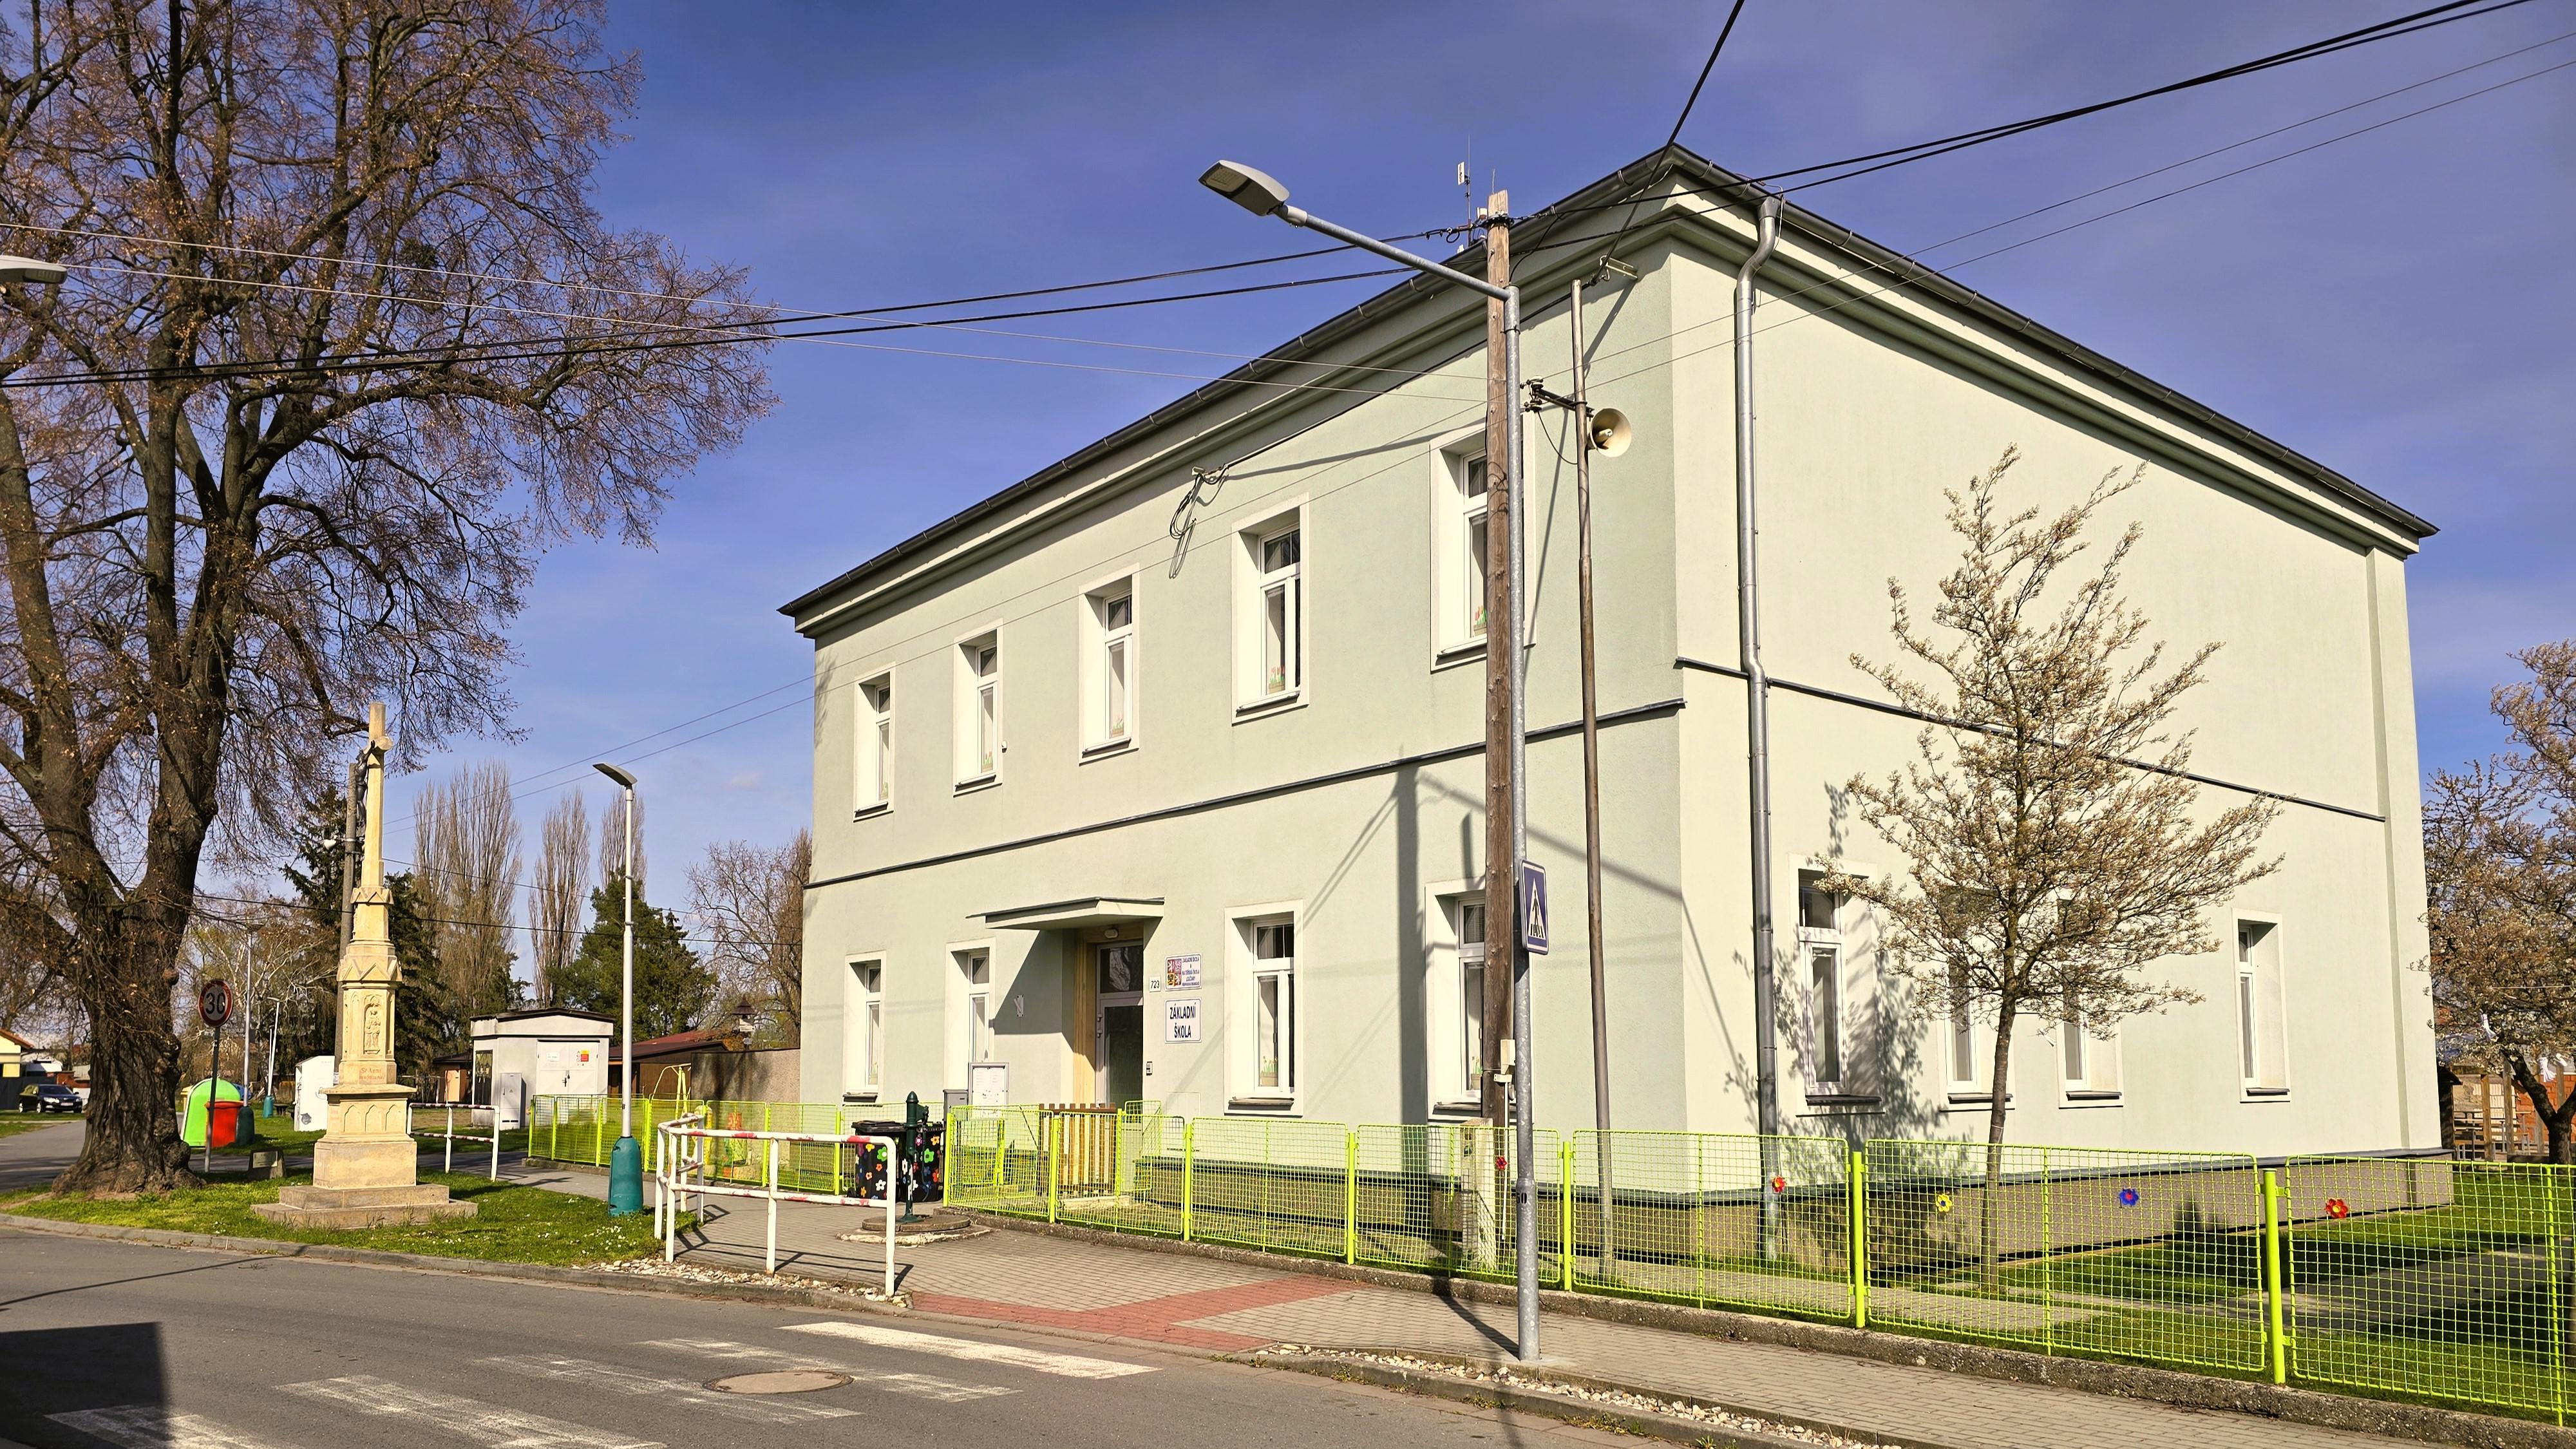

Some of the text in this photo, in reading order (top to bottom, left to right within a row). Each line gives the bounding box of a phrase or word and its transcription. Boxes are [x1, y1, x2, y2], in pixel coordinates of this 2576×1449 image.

[1151, 980, 1160, 989] 723
[205, 992, 225, 1014] 30
[1170, 1002, 1196, 1019] ZÁKLADNÍ
[1174, 1023, 1191, 1038] ŠKOLA
